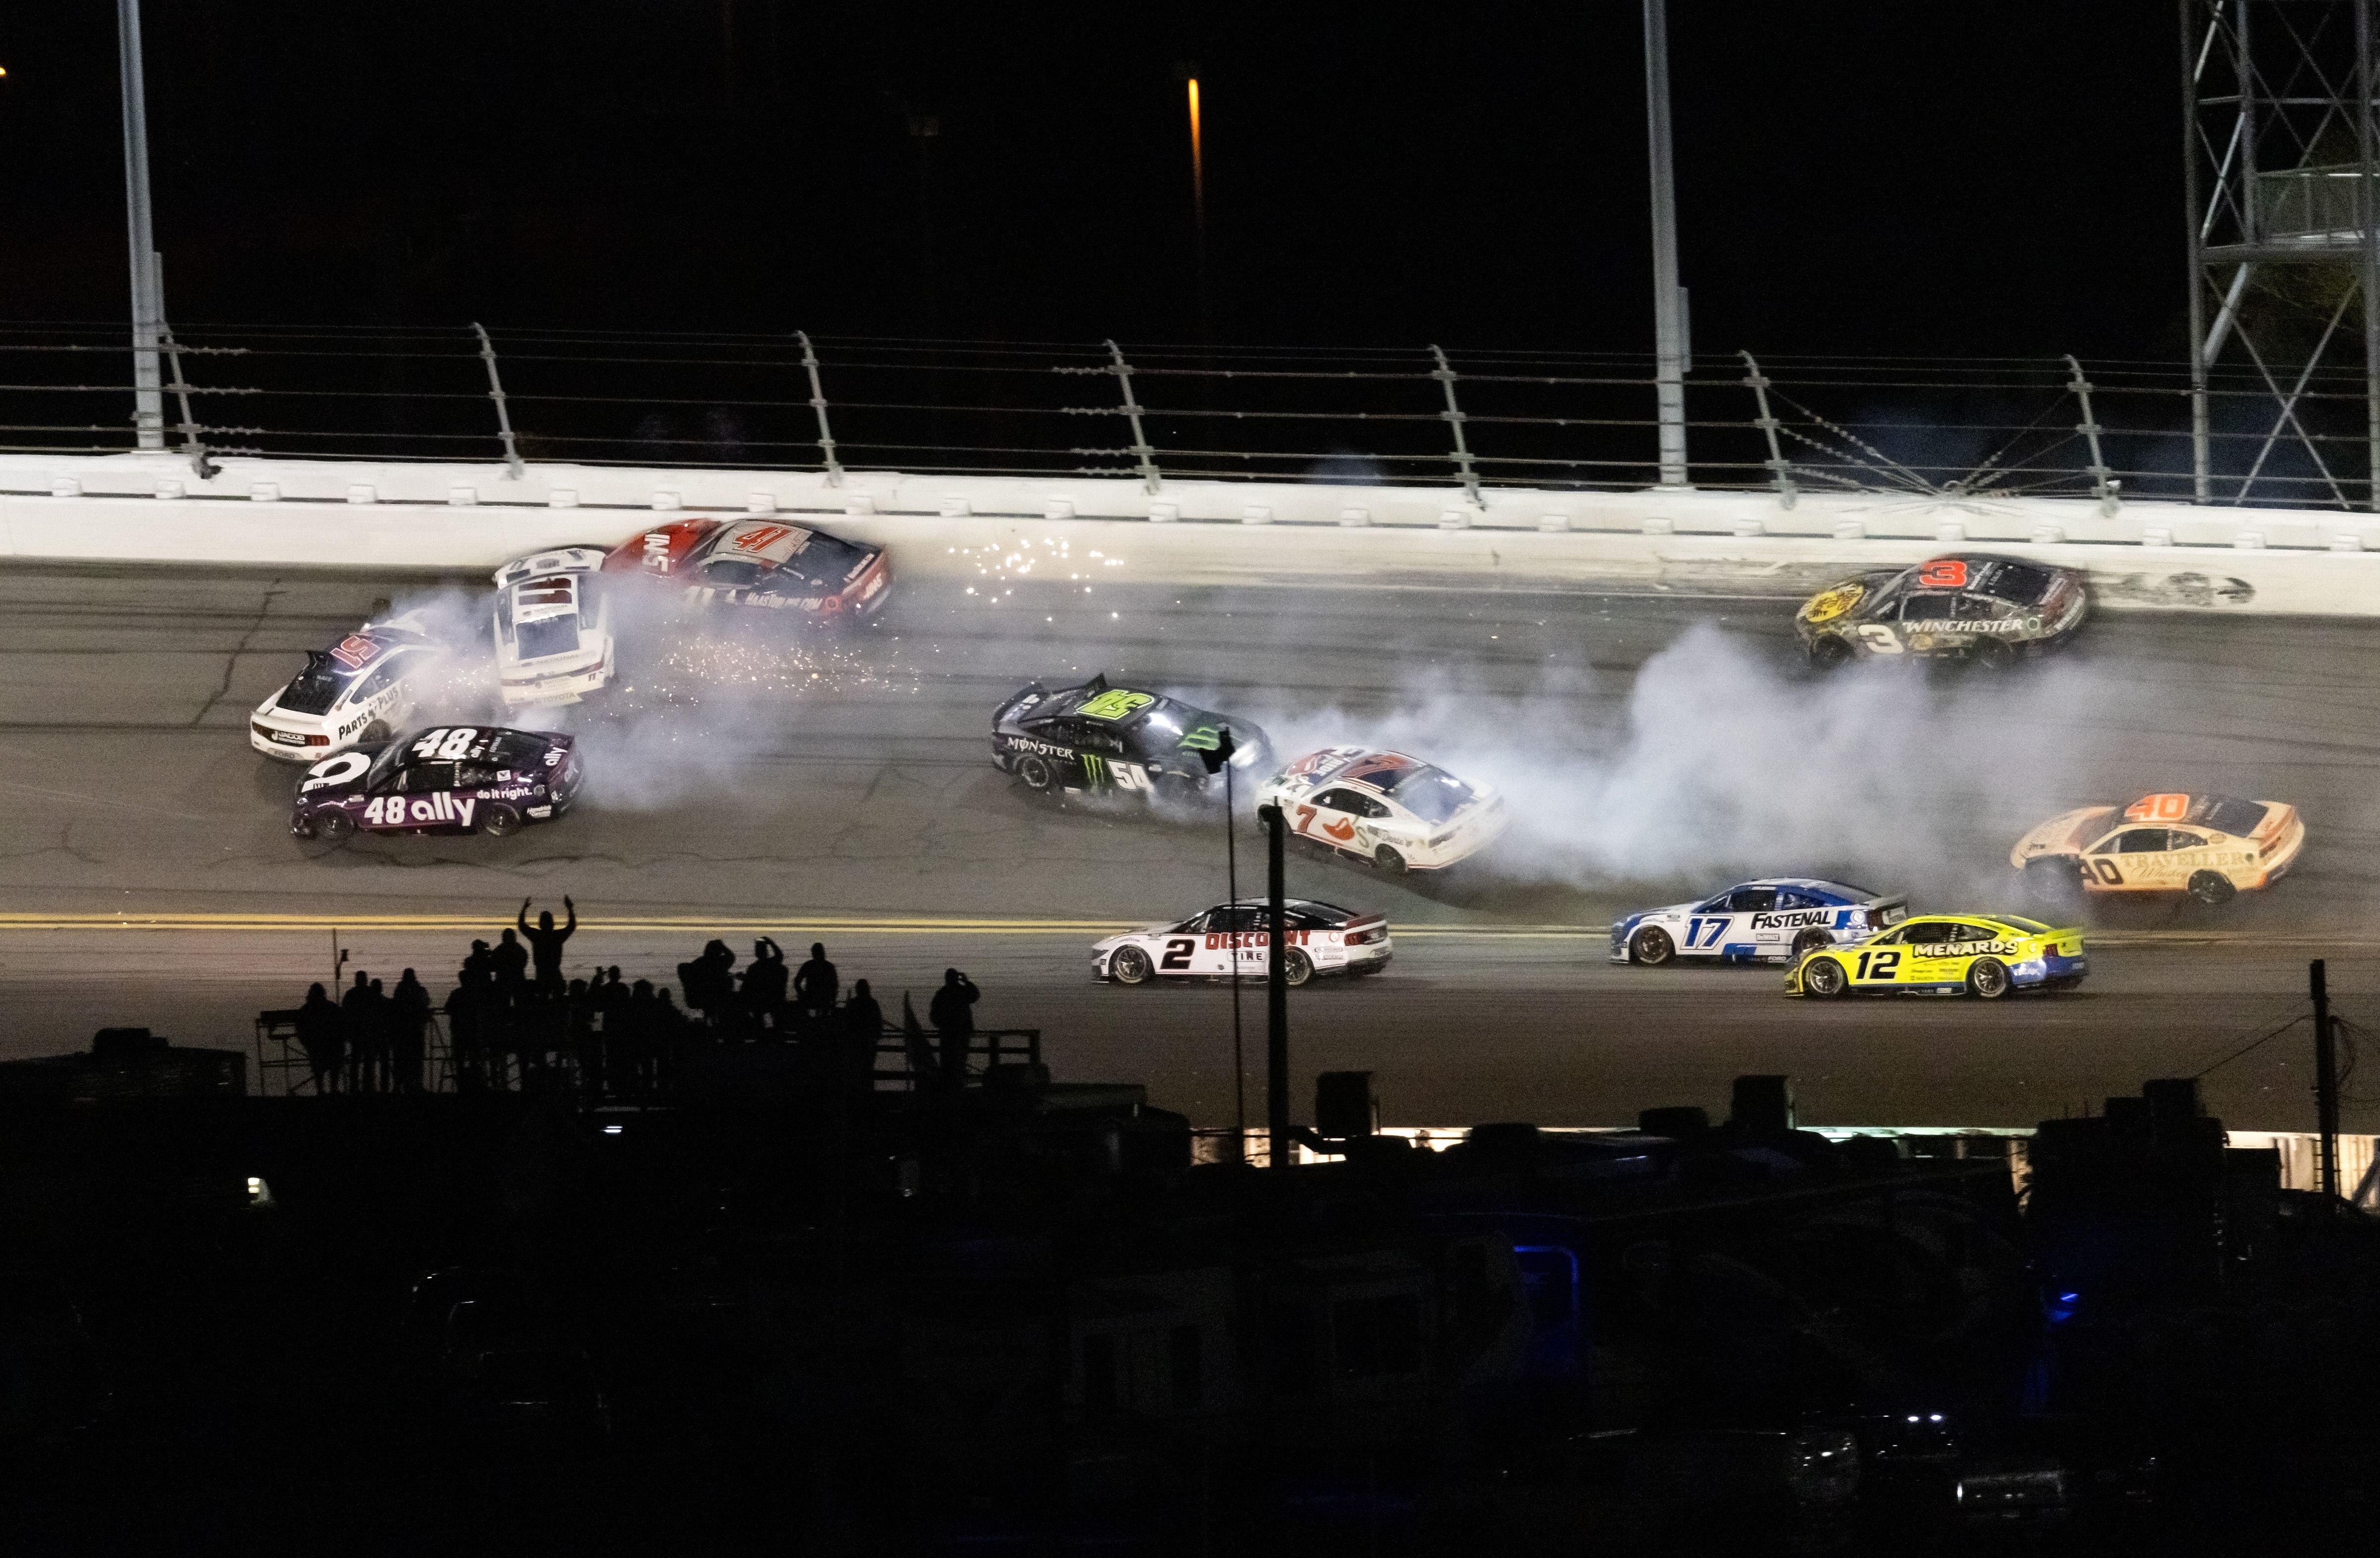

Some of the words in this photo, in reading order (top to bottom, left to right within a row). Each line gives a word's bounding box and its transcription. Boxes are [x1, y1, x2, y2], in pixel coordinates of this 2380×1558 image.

[732, 526, 796, 553] 41
[1919, 560, 1967, 588] 3
[1857, 624, 1903, 654] 3
[1901, 619, 2023, 633] WINCHESTER
[338, 713, 368, 740] PARTS
[377, 686, 398, 710] PLUS
[1075, 689, 1155, 720] 54
[274, 750, 295, 759] FORD
[411, 728, 477, 760] 48
[470, 745, 485, 758] ally
[544, 747, 568, 766] ally
[1007, 736, 1075, 760] MONSTER
[1105, 758, 1154, 793] 54
[477, 789, 491, 799] do
[491, 788, 500, 799] it
[501, 787, 533, 800] right.
[2124, 793, 2190, 822] 40
[364, 796, 406, 825] 48
[411, 791, 475, 827] ally
[1296, 804, 1317, 833] 7
[2079, 858, 2125, 885] 40
[2121, 853, 2246, 867] TRAVELLER
[1680, 915, 1735, 950] 17
[1750, 911, 1831, 929] FASTENAL
[1160, 939, 1196, 970] 2
[1205, 930, 1311, 950] DISCONT
[1231, 952, 1263, 961] TIRE
[1913, 940, 2019, 958] MENARDS
[1855, 952, 1901, 979] 12
